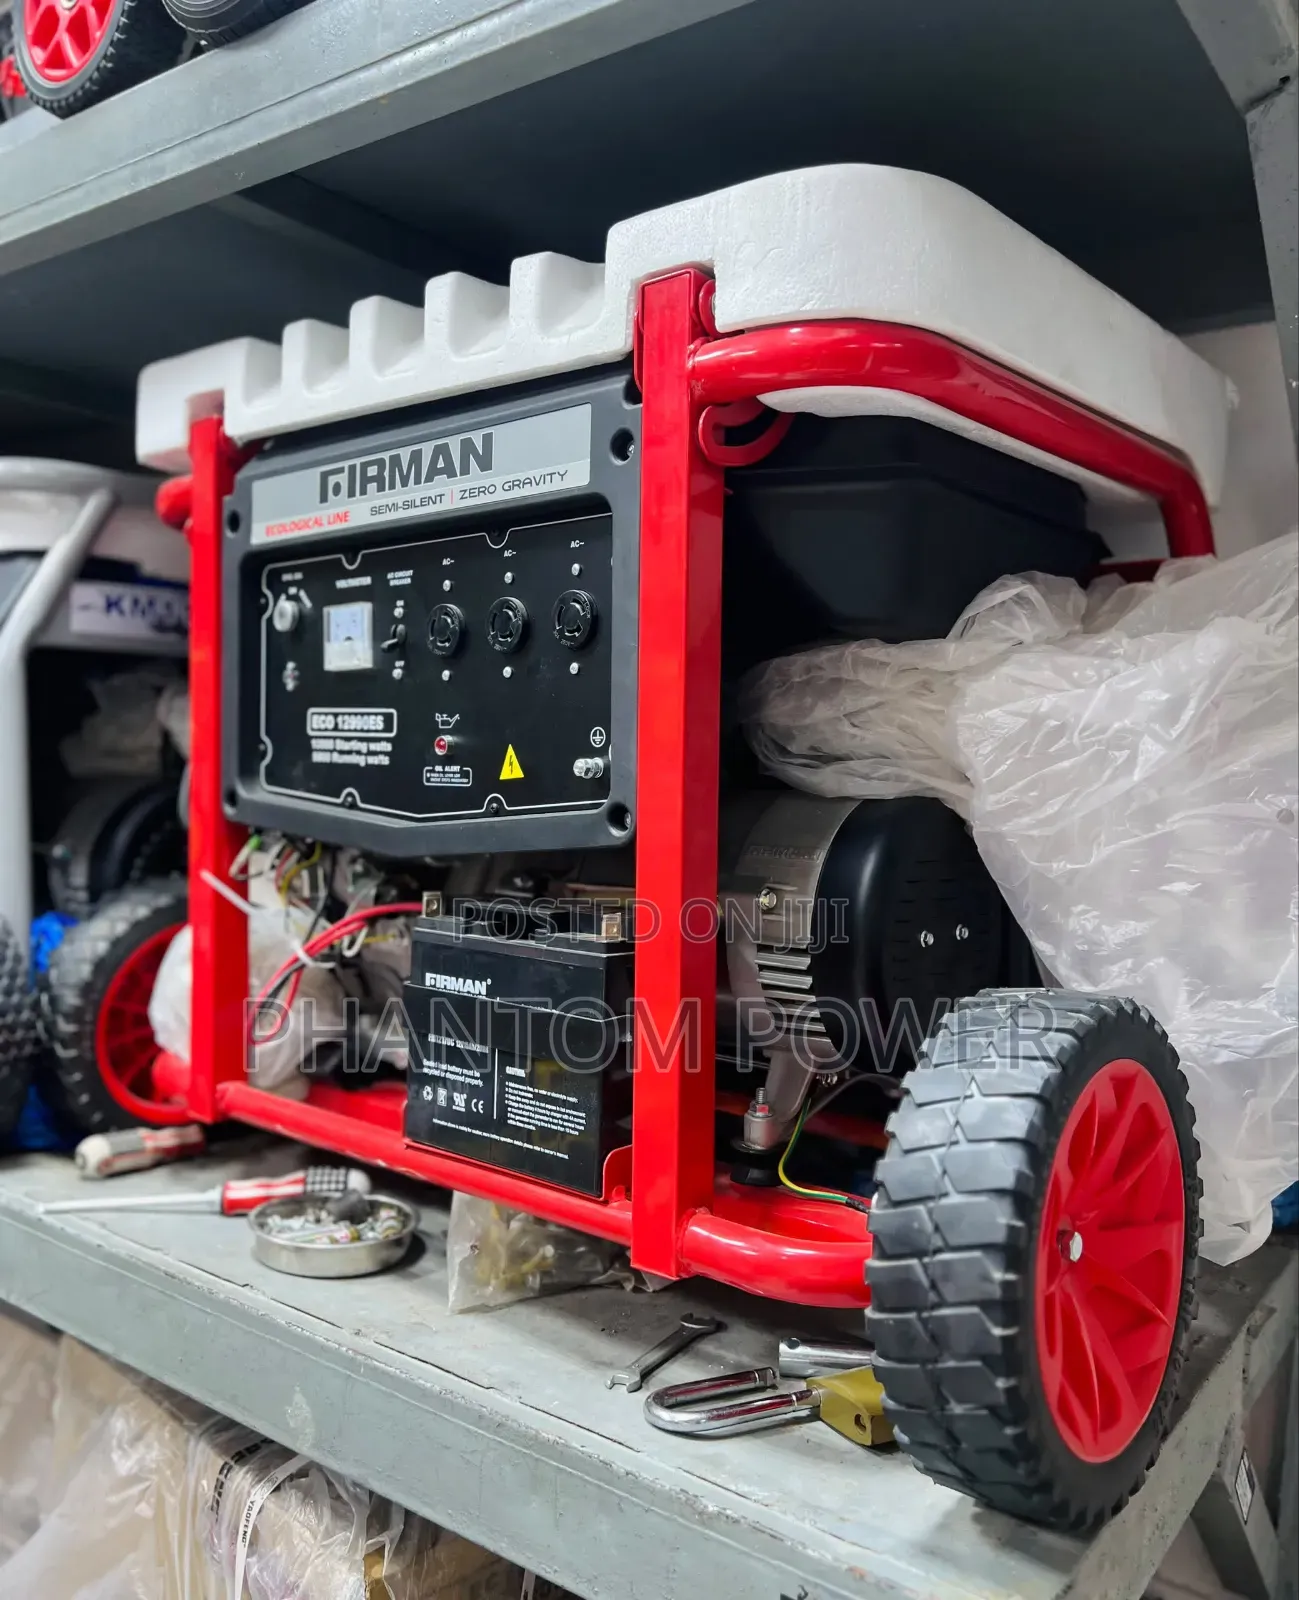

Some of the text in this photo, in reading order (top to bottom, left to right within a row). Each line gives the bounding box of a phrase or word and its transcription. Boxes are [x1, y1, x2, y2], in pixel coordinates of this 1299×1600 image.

[320, 430, 494, 504] FIRMAN
[458, 470, 568, 500] ZERO GRAVITY
[370, 493, 445, 516] SEMI-SILENT
[265, 511, 350, 538] ECOLOGICAL LINE
[312, 714, 335, 730] ECO
